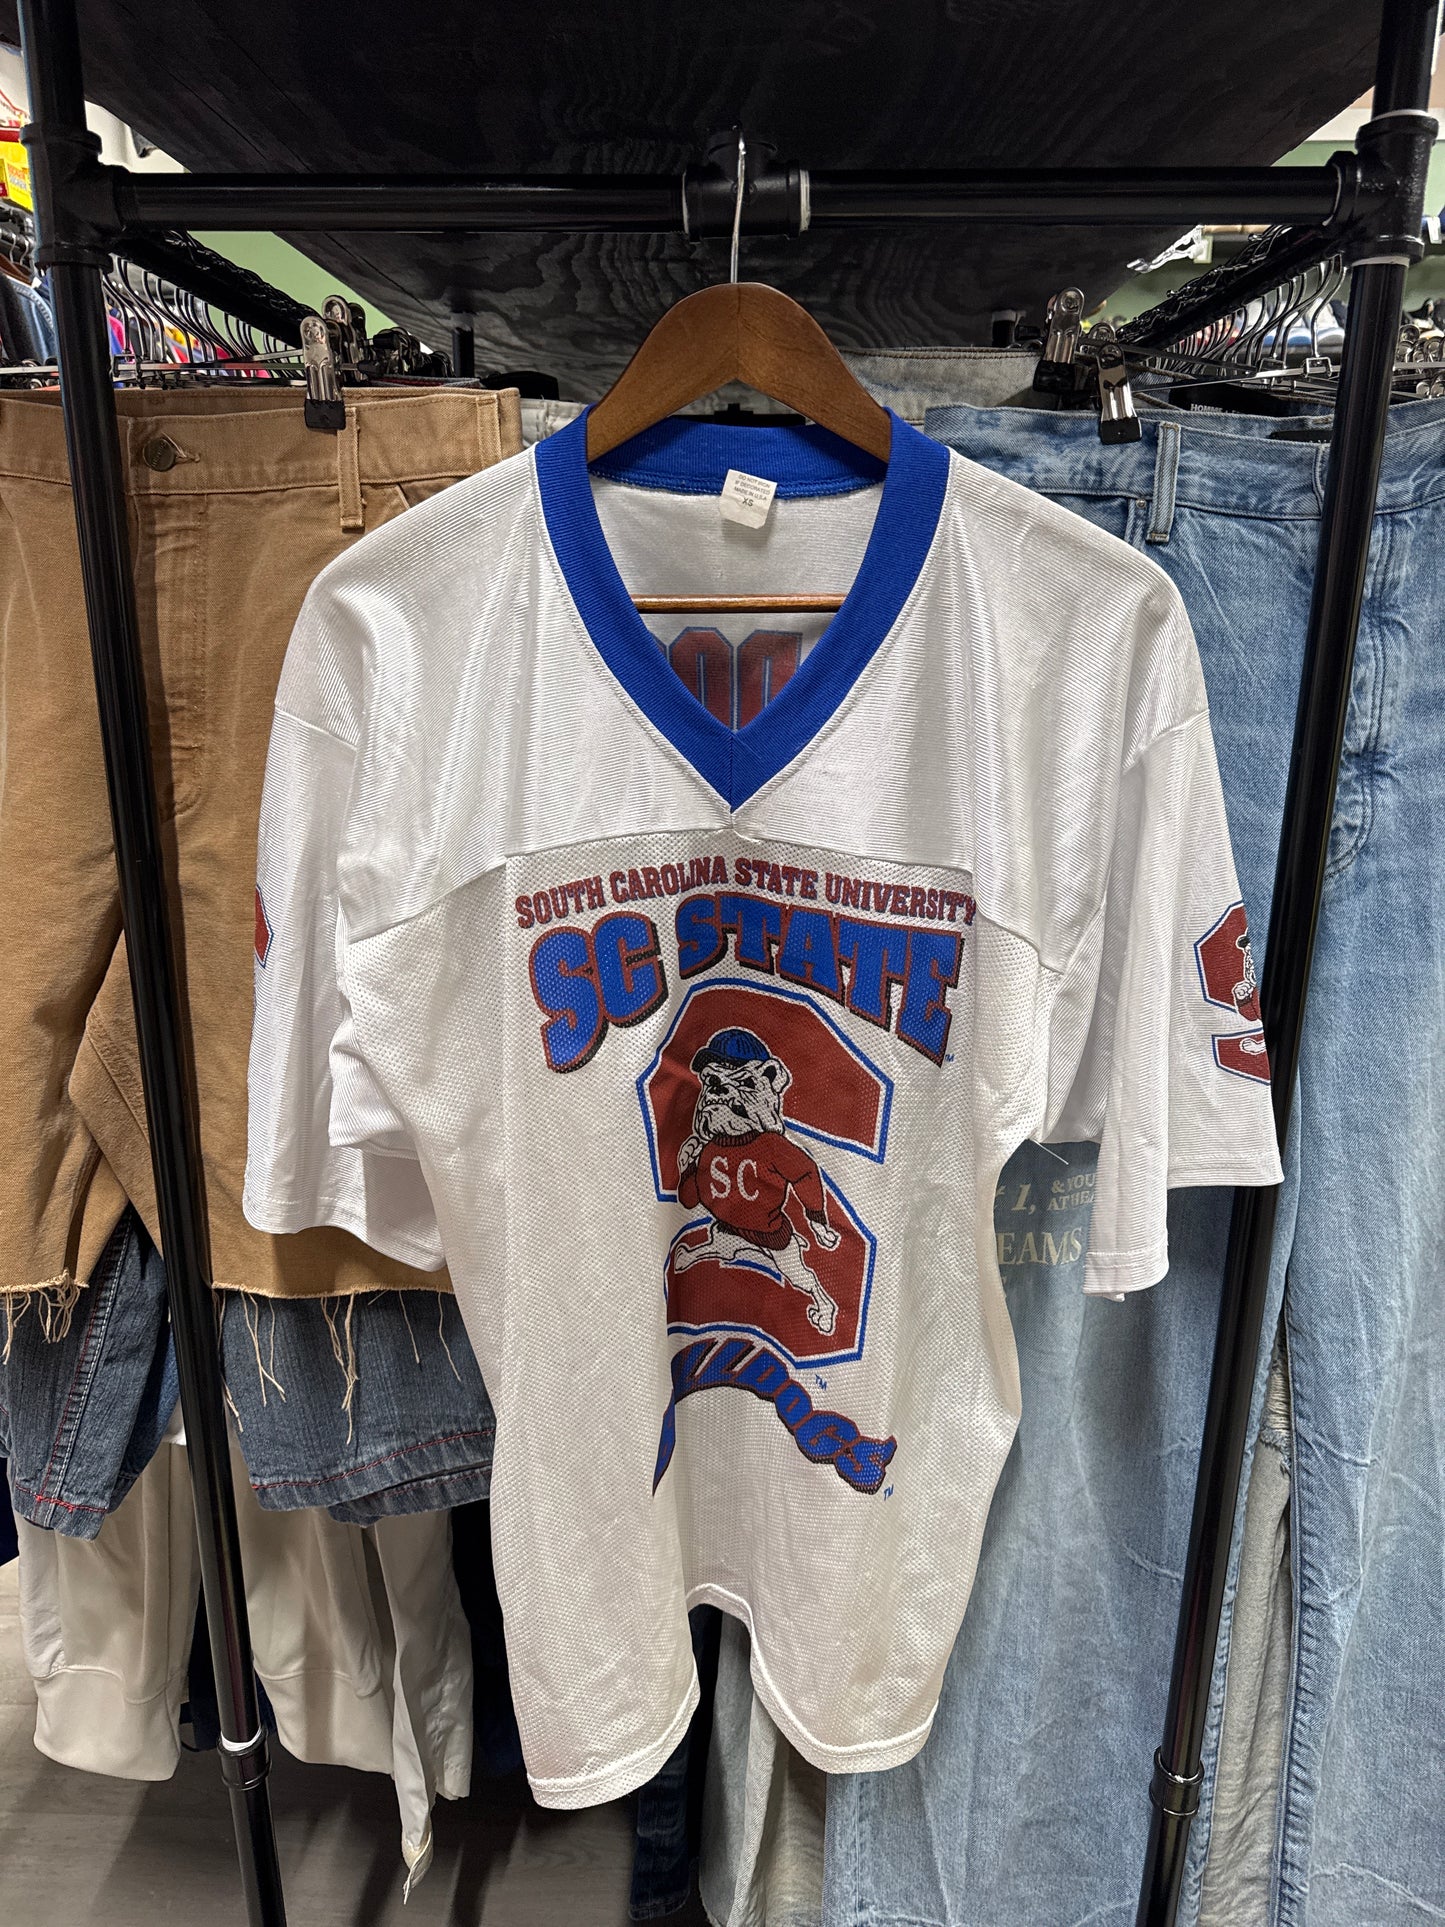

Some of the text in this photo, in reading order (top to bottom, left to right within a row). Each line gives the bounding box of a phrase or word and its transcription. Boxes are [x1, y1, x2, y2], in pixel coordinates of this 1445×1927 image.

[734, 486, 748, 495] MADE
[742, 497, 754, 506] XS
[515, 855, 977, 929] SOUTH CAROLINA STATE UNIVERSITY
[528, 890, 966, 1074] SC STATE
[709, 1155, 760, 1202] SC
[1051, 1179, 1065, 1194] &
